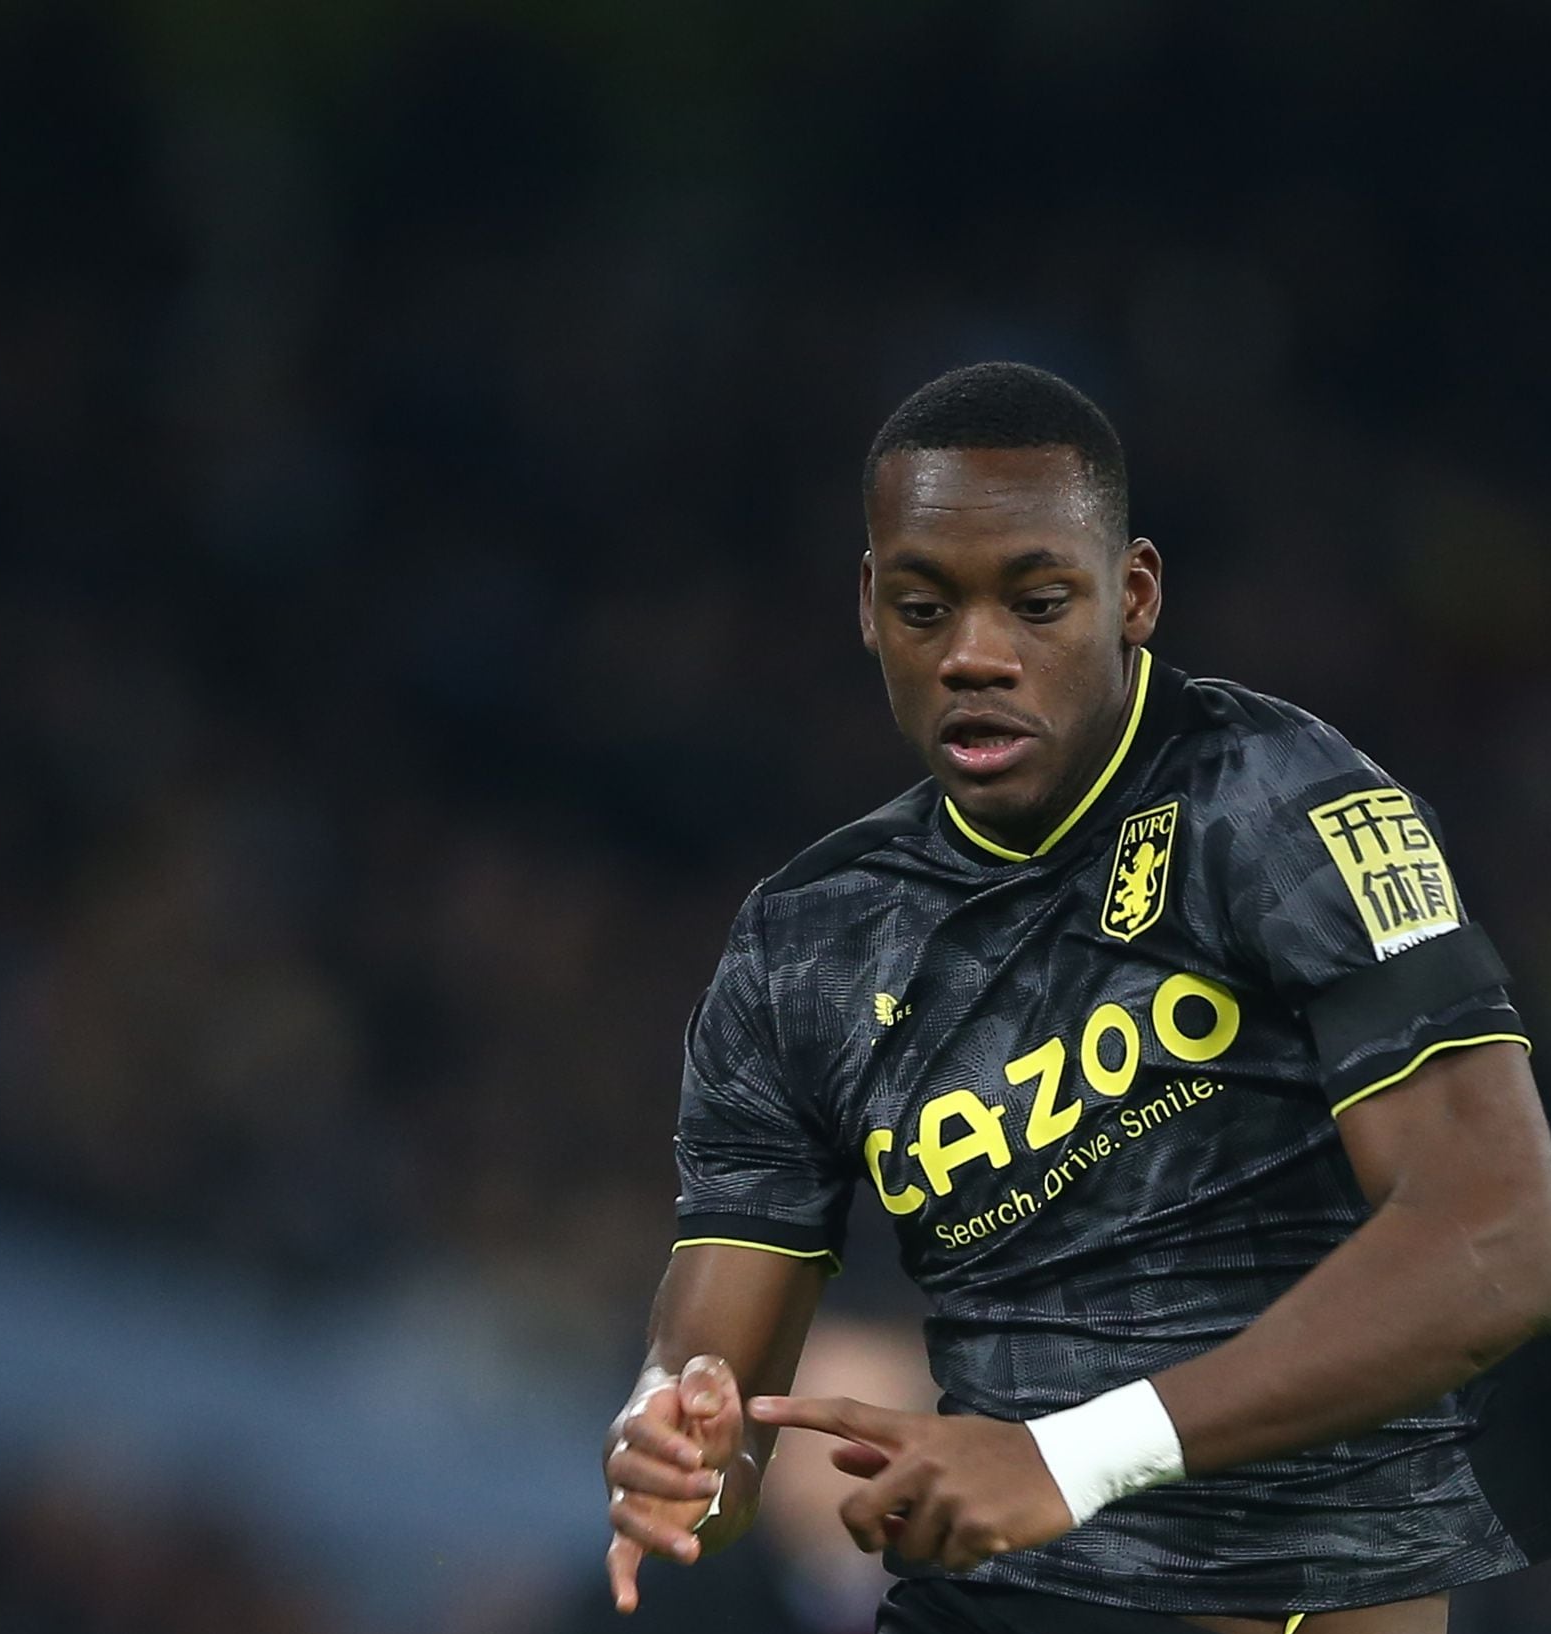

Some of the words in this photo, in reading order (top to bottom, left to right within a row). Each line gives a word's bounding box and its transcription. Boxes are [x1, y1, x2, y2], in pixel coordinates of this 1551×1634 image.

[1123, 811, 1173, 846] AVFC
[1320, 795, 1431, 865] 开云
[1362, 858, 1453, 932] 体育
[864, 972, 1240, 1215] CAZOO
[935, 1189, 1043, 1250] Search.
[1044, 1132, 1122, 1200] Drive.
[1120, 1077, 1225, 1140] Smile.
